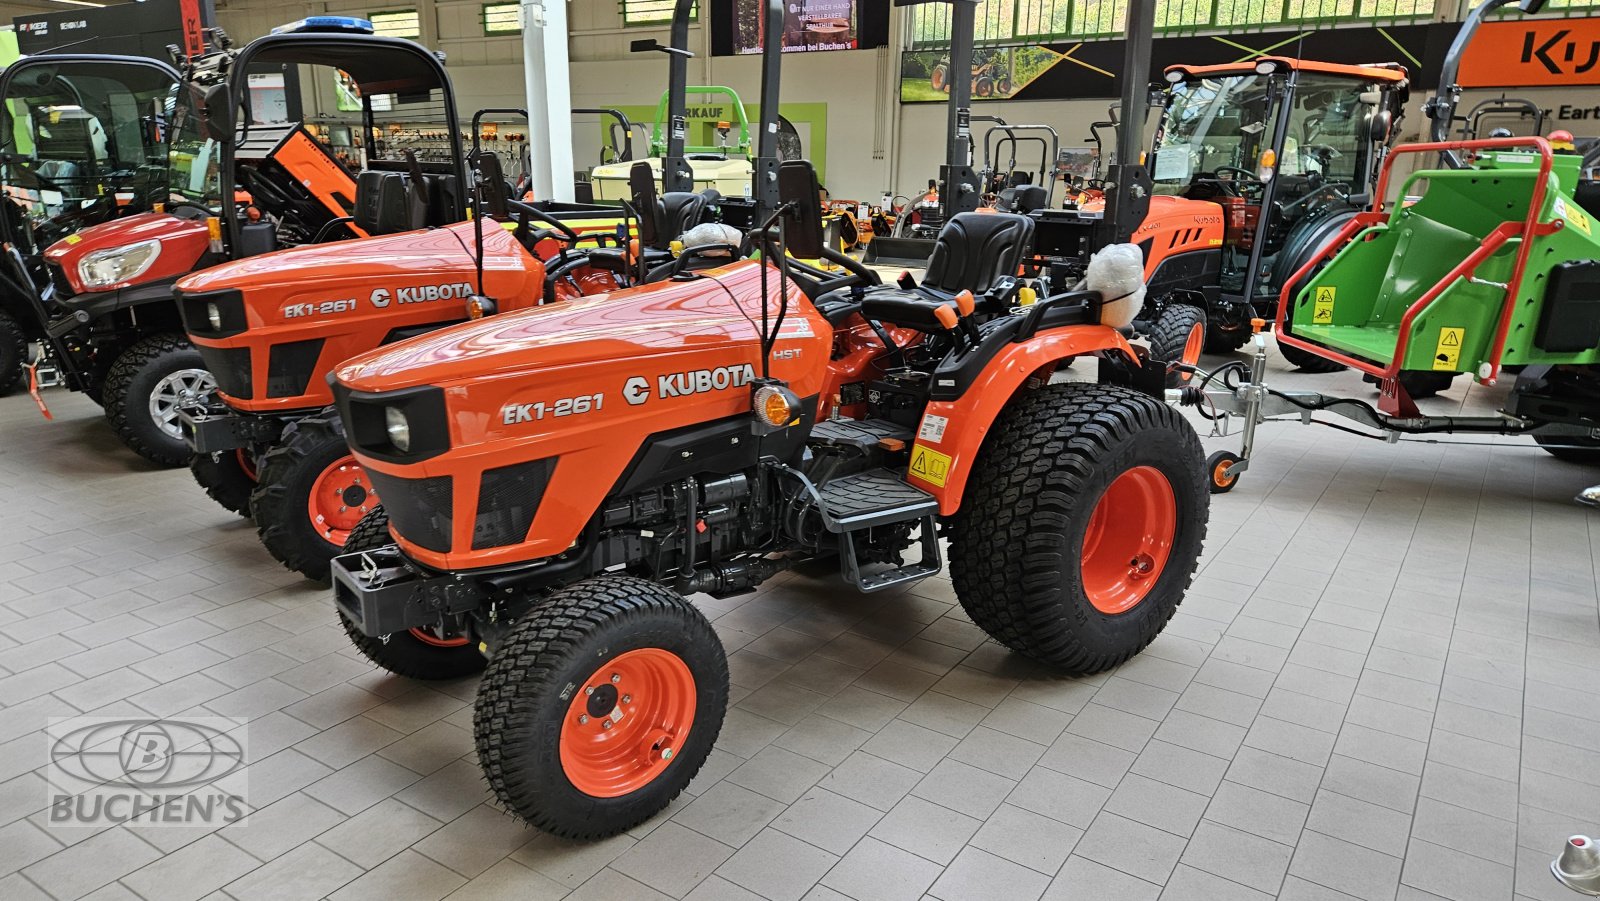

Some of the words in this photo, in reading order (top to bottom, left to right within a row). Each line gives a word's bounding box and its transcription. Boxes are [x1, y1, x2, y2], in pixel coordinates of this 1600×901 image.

[742, 46, 764, 54] Herzlic
[781, 45, 806, 53] ommen
[807, 43, 818, 52] bei
[685, 107, 723, 118] RKAUF
[1559, 105, 1600, 120] Eart
[284, 299, 357, 319] EK1-261
[396, 282, 475, 304] KUBOTA
[772, 348, 802, 360] HST
[502, 393, 605, 425] EK1-261
[657, 363, 757, 399] KUBOTA
